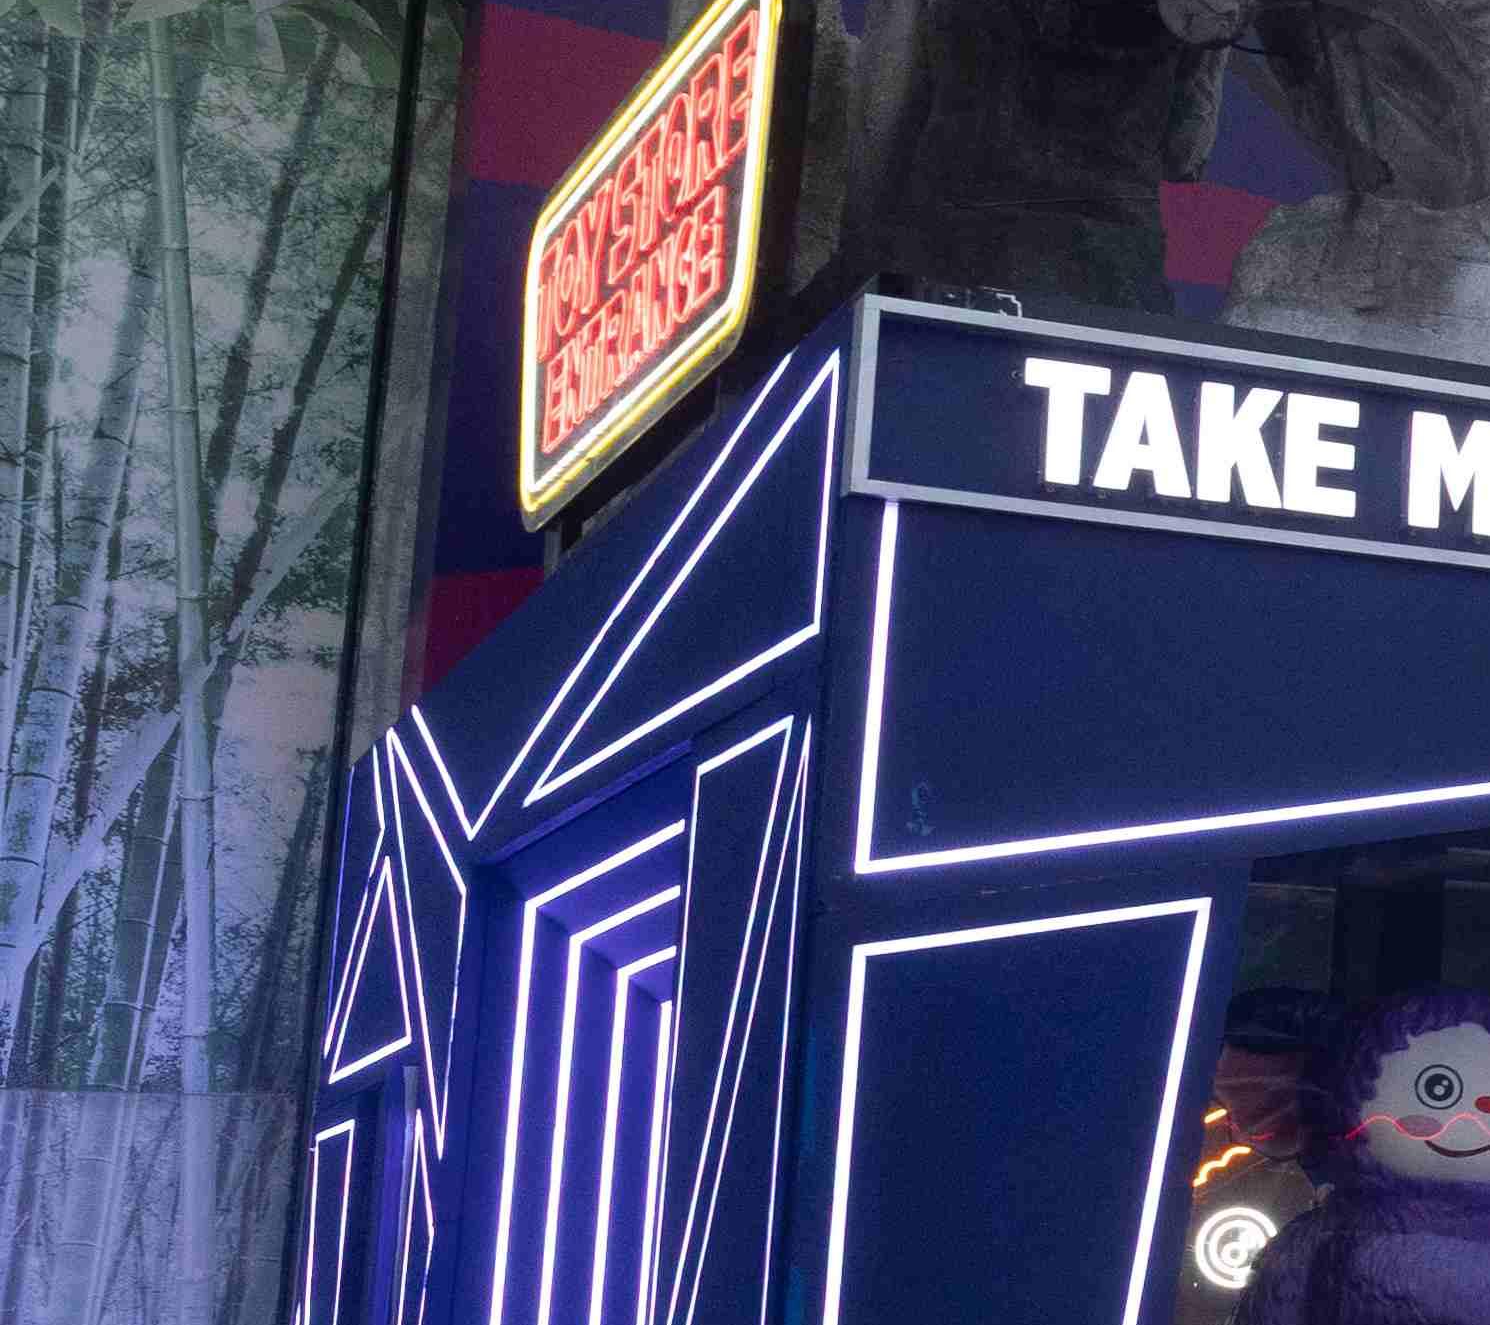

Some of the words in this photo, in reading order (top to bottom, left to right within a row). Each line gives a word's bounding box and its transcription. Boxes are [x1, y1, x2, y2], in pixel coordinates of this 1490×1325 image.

[536, 179, 613, 362] TOY
[608, 8, 760, 286] STORE
[541, 184, 727, 454] ENTRANCE
[1024, 356, 1360, 519] TAKE
